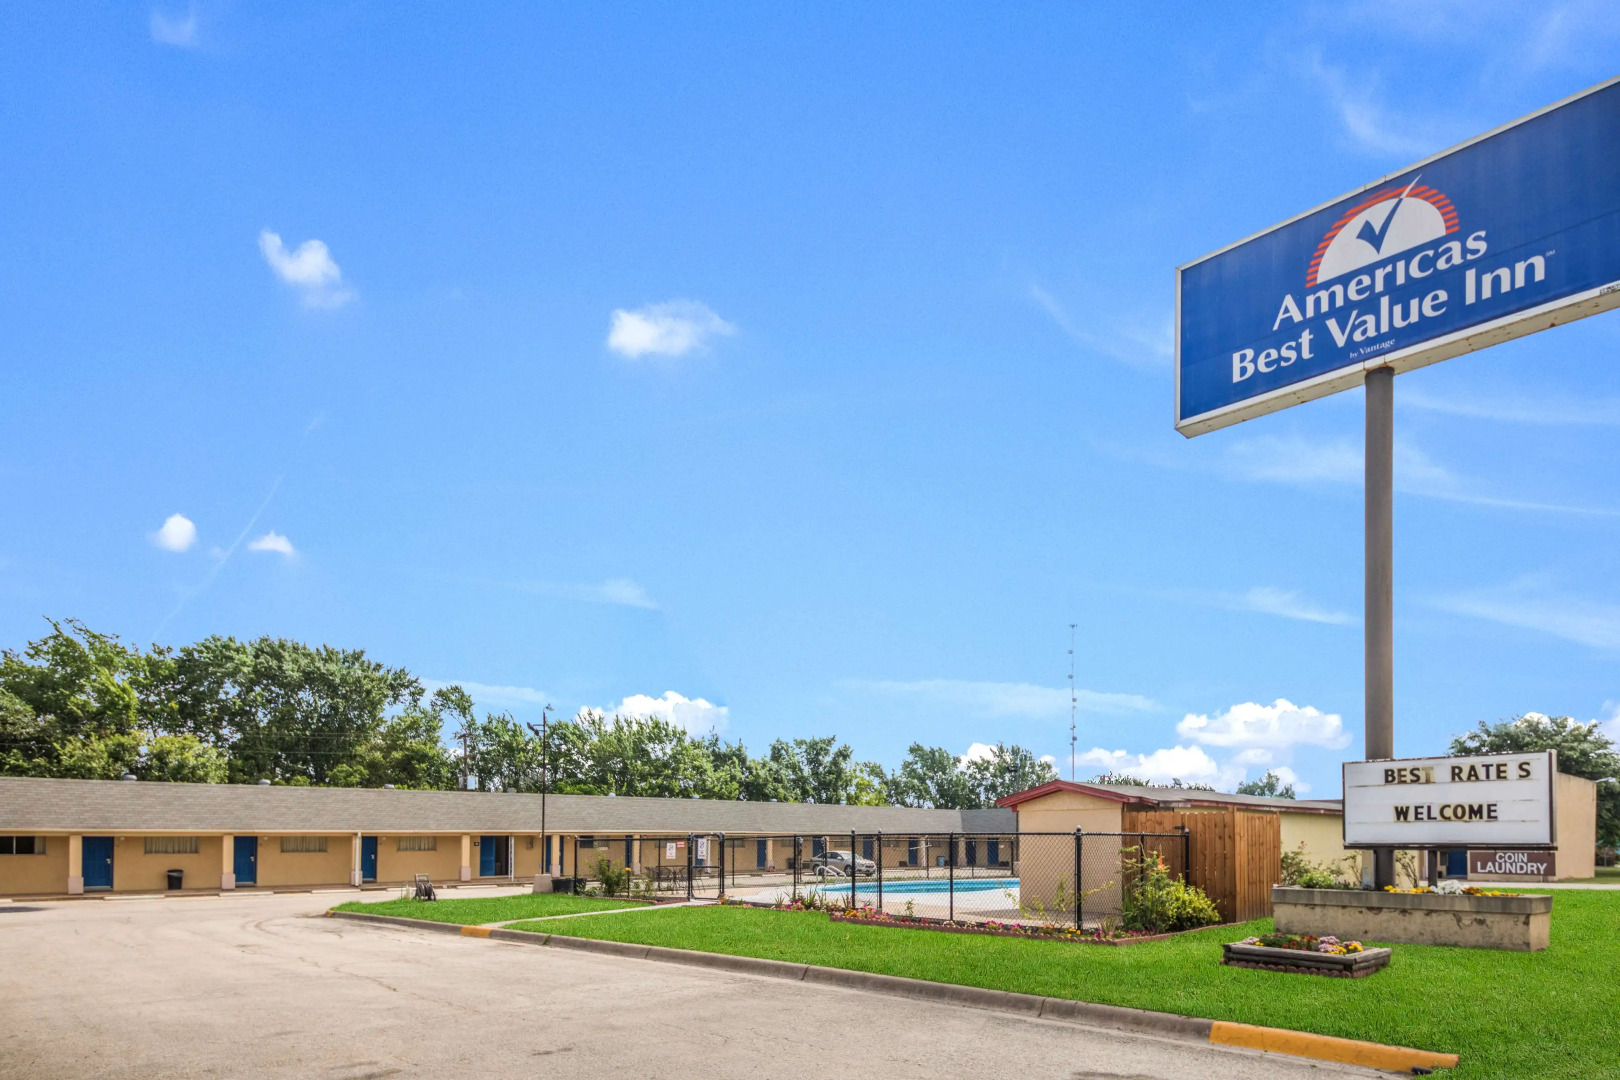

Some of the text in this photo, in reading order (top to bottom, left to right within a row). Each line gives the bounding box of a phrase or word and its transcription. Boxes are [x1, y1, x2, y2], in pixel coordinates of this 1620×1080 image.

[1272, 230, 1488, 331] Americas
[1232, 328, 1314, 384] Best
[1325, 289, 1448, 348] Value
[1465, 255, 1545, 306] Inn
[1349, 338, 1396, 359] by Vantage
[1384, 766, 1434, 784] BEST
[1394, 803, 1498, 821] WELCOME
[1495, 852, 1528, 863] COIN
[1476, 861, 1548, 875] LAUNDRY
